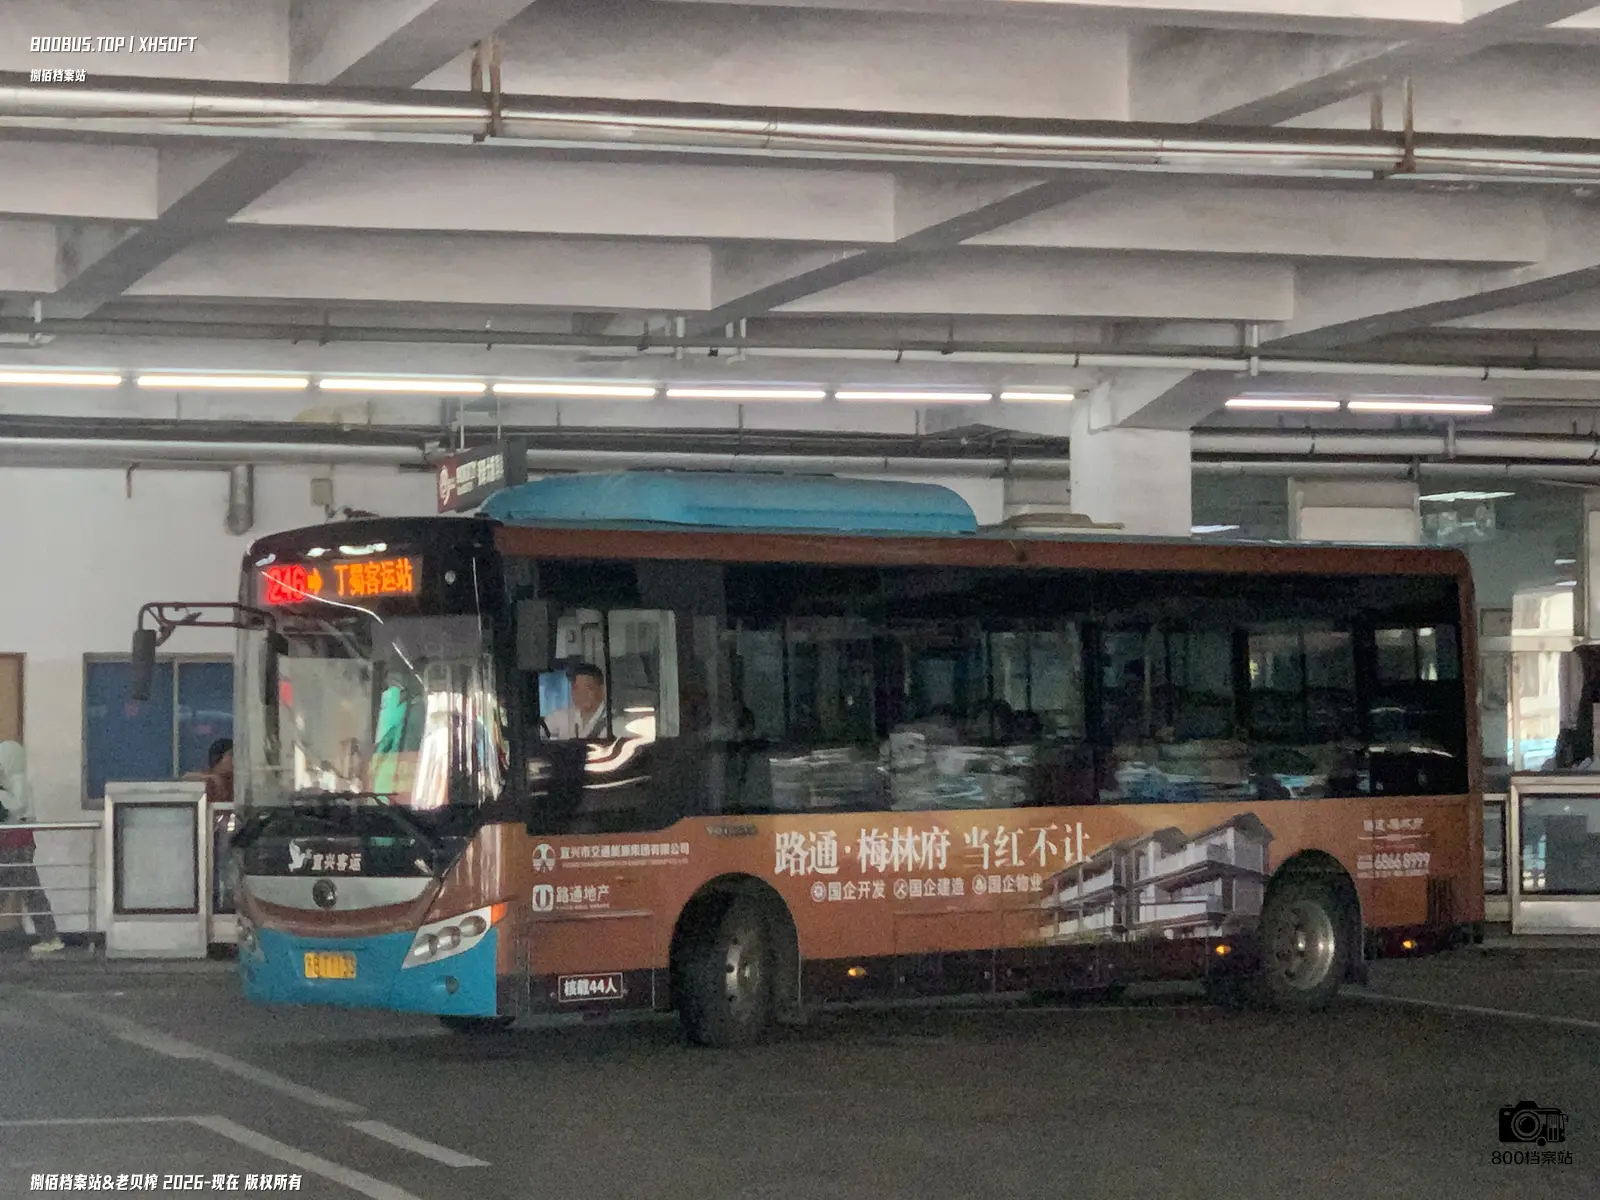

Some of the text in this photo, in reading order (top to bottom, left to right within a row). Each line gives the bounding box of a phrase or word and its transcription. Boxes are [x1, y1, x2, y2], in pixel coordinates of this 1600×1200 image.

[266, 564, 307, 604] 246
[963, 821, 1093, 870] 当红不让
[556, 884, 610, 904] 路通地产
[827, 880, 886, 901] 国企开发
